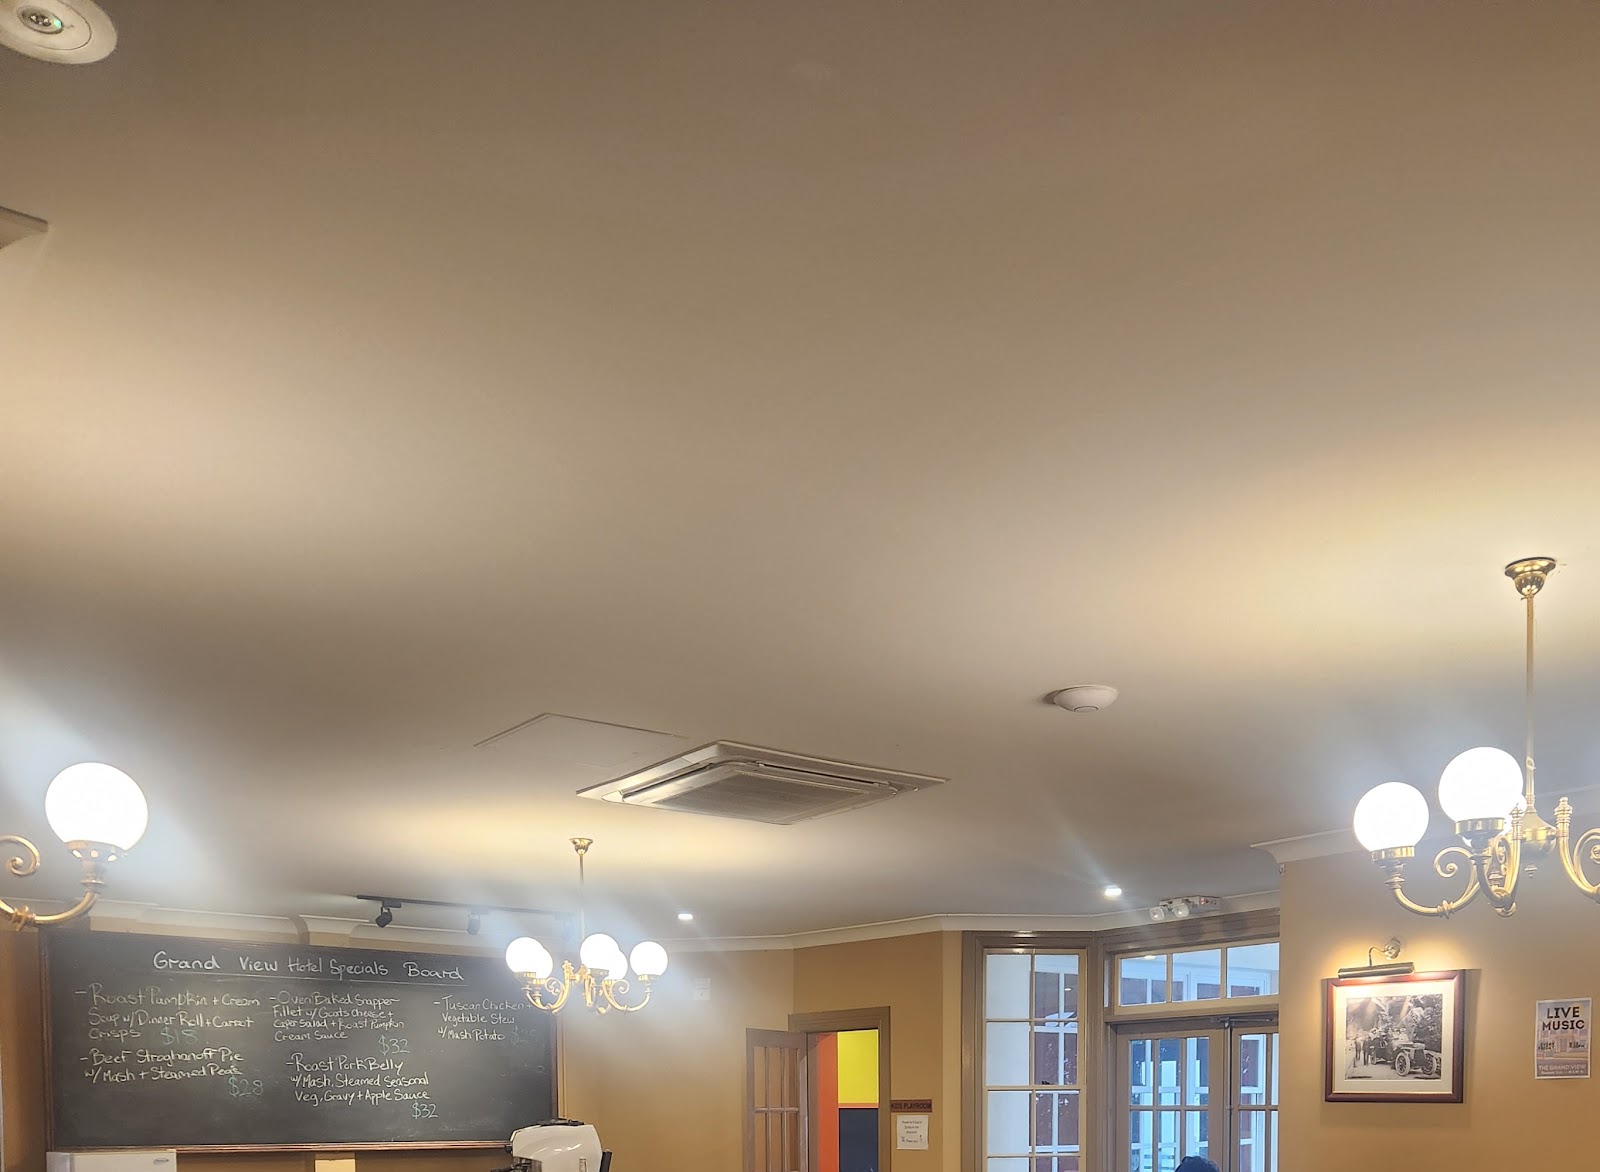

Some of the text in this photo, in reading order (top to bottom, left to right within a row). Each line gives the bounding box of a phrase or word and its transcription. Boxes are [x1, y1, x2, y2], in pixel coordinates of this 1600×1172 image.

[153, 951, 464, 981] Grand View Hotel Specials Board
[146, 986, 208, 1009] Pumpkin
[221, 993, 260, 1006] Cream
[311, 992, 353, 1005] Baked
[354, 994, 400, 1010] Snapper
[482, 998, 524, 1011] Chicken
[88, 1007, 119, 1026] Soup
[175, 1011, 203, 1027] Roll
[212, 1016, 254, 1028] Carrot
[272, 1004, 302, 1018] Fillet
[318, 1006, 349, 1019] Goats
[351, 1009, 386, 1018] Cheese
[442, 1011, 515, 1027] Vegetable Stew
[1547, 1006, 1580, 1019] LIVE
[300, 1018, 329, 1030] Salad
[338, 1018, 367, 1031] Roast
[370, 1019, 405, 1031] Pumpkin
[1542, 1020, 1585, 1031] MUSIC
[88, 1028, 141, 1044] Crisps
[274, 1029, 410, 1055] Cream Sauce $32
[448, 1028, 471, 1040] Mash
[472, 1029, 505, 1041] Potato
[218, 1047, 244, 1062] Pie
[335, 1055, 367, 1070] Pork
[365, 1057, 404, 1076] Belly
[103, 1068, 135, 1083] Mash
[150, 1065, 207, 1080] Steamed
[228, 1074, 263, 1097] $28
[336, 1073, 380, 1088] Steamed
[384, 1071, 429, 1088] Seasonal
[324, 1090, 355, 1106] Gravy
[365, 1089, 392, 1106] Apple
[394, 1088, 430, 1100] Sauce
[411, 1099, 438, 1120] $32
